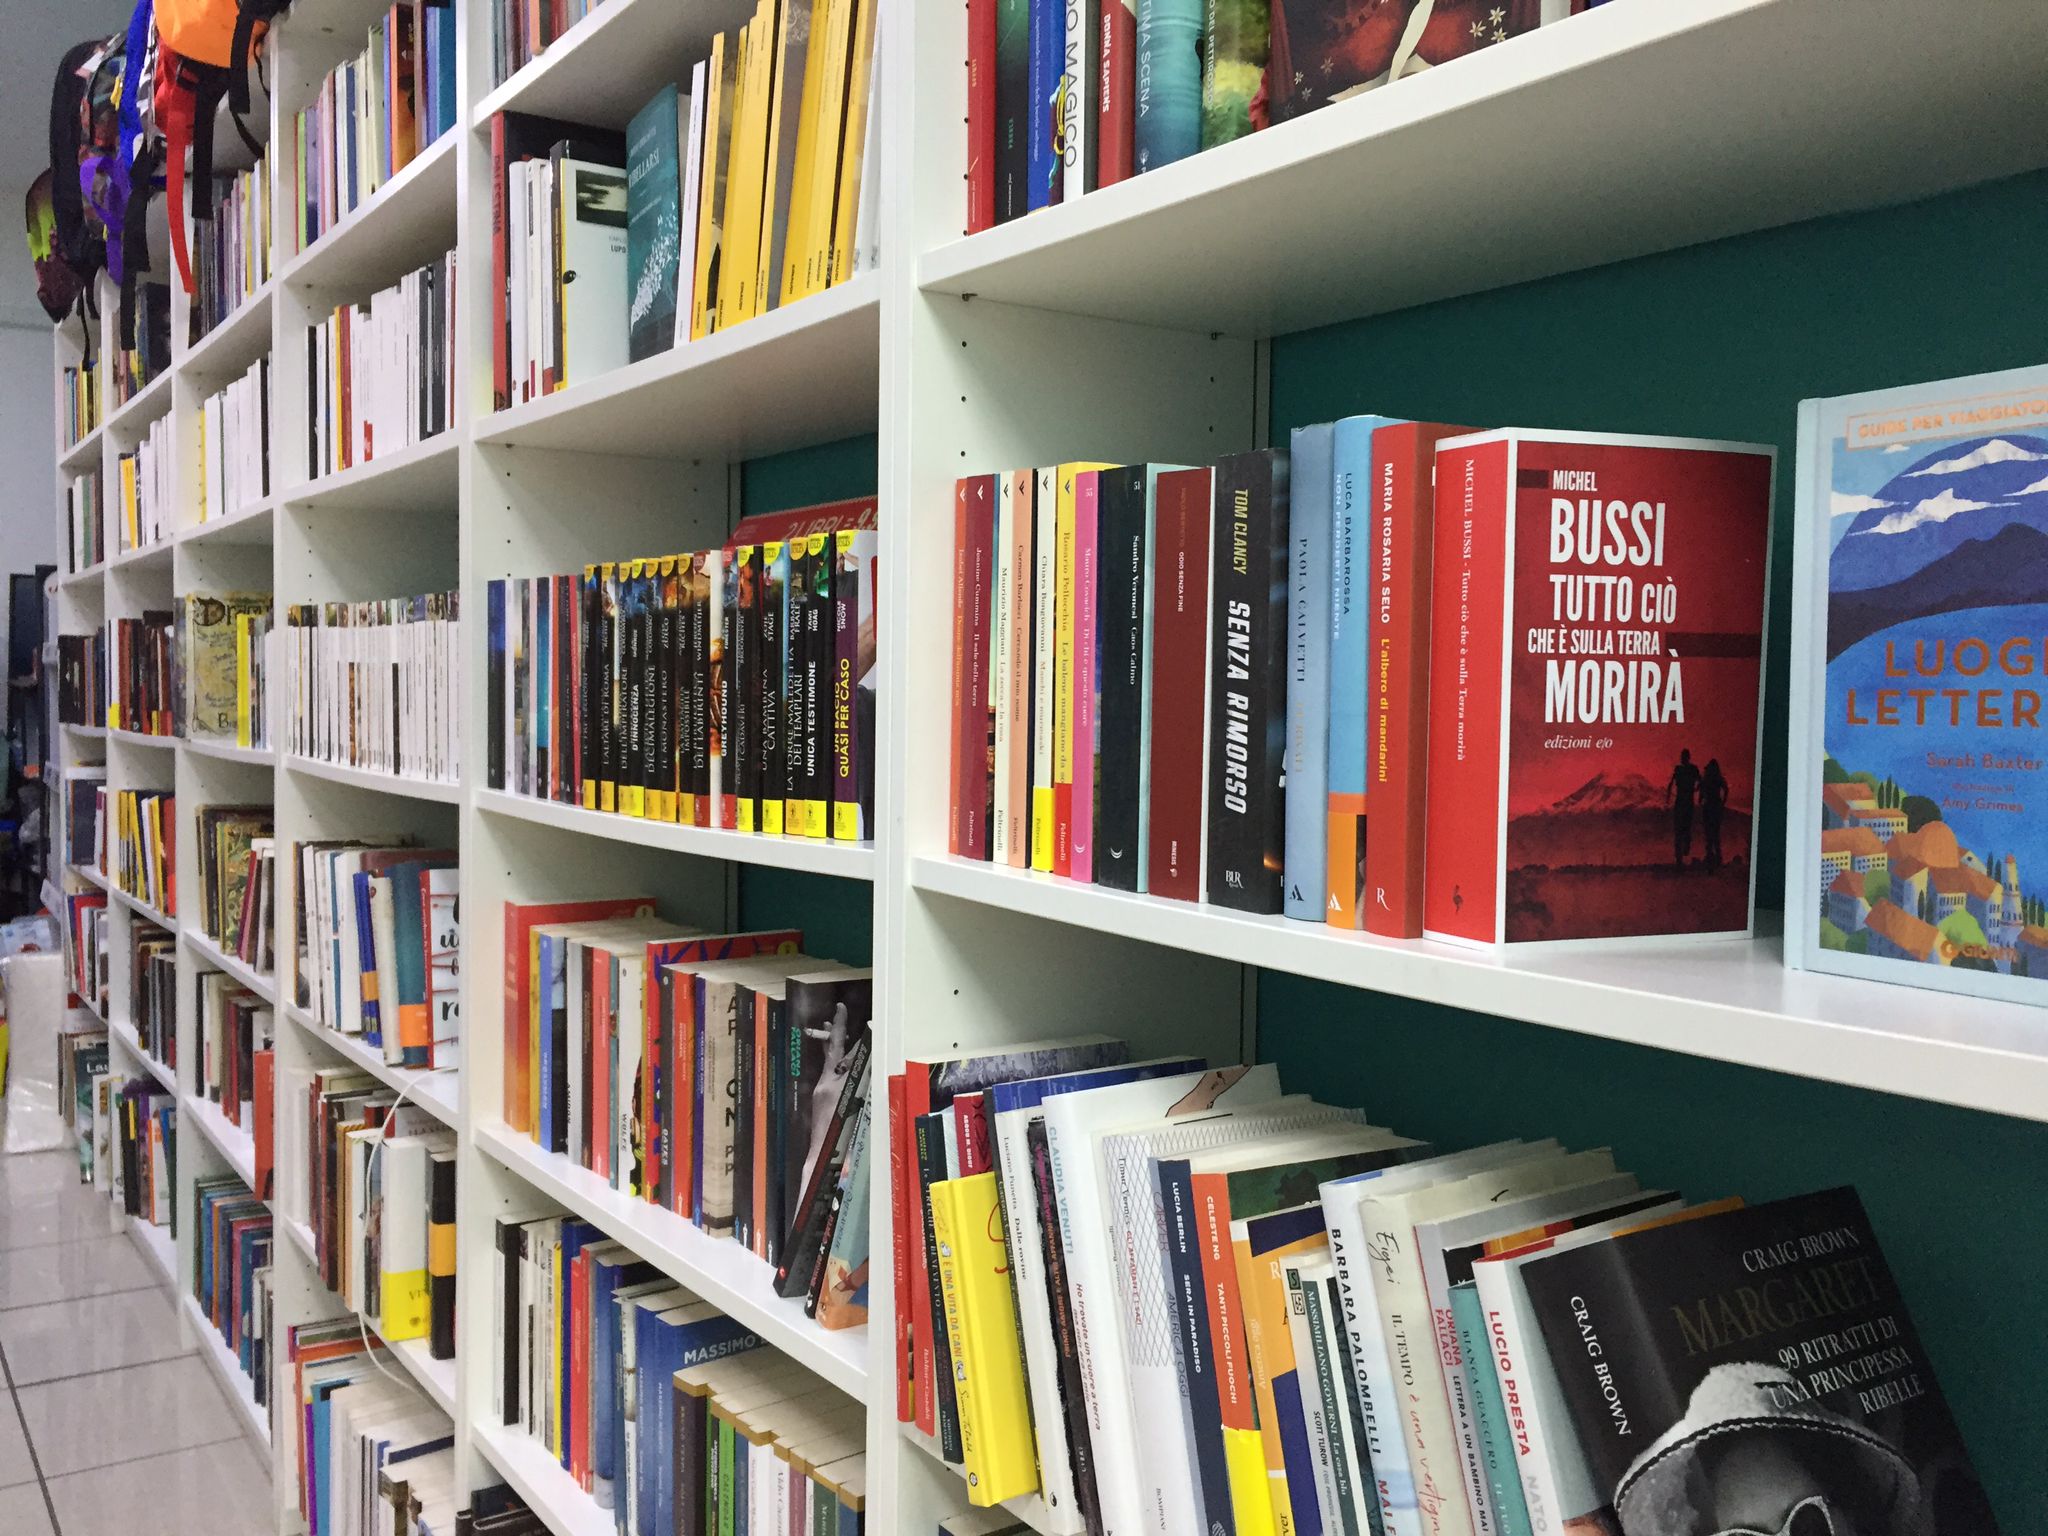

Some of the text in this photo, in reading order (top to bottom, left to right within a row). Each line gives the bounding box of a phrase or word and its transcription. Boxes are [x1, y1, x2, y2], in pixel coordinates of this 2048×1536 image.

[1065, 41, 1078, 168] MAGICO
[1102, 60, 1111, 113] SAPIENS
[1140, 50, 1151, 118] SCENA
[1858, 418, 1906, 440] GUIDE
[1912, 413, 1944, 431] PER
[1464, 459, 1474, 516] MICHEL
[1552, 469, 1598, 492] MICHEL
[1343, 473, 1353, 615] LUCA BARBAROSSA
[1462, 520, 1473, 559] BUSSI
[1549, 498, 1666, 567] BUSSI
[1296, 539, 1308, 683] PAOLA CALVETTI
[1460, 604, 1470, 622] ciò
[1461, 570, 1471, 601] Tutto
[1549, 575, 1677, 624] TUTTO CIÒ
[1379, 463, 1394, 783] MARIA ROSARIA SELO L'albero di mandarini
[1460, 625, 1470, 645] che
[1528, 626, 1661, 656] CHE È SULLA TERRA
[1224, 489, 1250, 814] TOM CLANCY SENZA RIMORSO
[1459, 658, 1469, 684] sulla
[1459, 688, 1468, 718] Terra
[1544, 648, 1685, 724] MORIRÀ
[793, 674, 802, 765] DEI TEMPLARI
[839, 658, 850, 777] QUASI PER CASO
[1457, 722, 1467, 760] morirà
[1544, 734, 1613, 751] edizioni e/o
[1927, 751, 2044, 771] Sarah Baxter
[1943, 797, 2024, 813] Amy Grimes
[1050, 1127, 1074, 1254] CLAUDIA VENUTI
[1118, 1157, 1127, 1187] Timur
[1207, 1196, 1219, 1242] CELESTE
[1741, 1225, 1860, 1274] CRAIG BROWN
[945, 1269, 962, 1358] UNA VITA DA CANI
[1153, 1192, 1191, 1398] CARVER AMERICA OGGI
[1177, 1217, 1186, 1253] BERLIN
[1183, 1273, 1192, 1302] SERA
[1189, 1317, 1201, 1373] PARADISO
[1216, 1282, 1225, 1314] TANTI
[1671, 1255, 1882, 1360] MARGARET
[684, 1335, 756, 1364] MASSIMO
[1078, 1301, 1090, 1338] trovato
[1087, 1356, 1096, 1388] cuore
[1221, 1316, 1232, 1359] PICCOLI
[1307, 1290, 1329, 1376] MASSIMILIANO
[1324, 1377, 1337, 1435] GOVERNI
[1434, 1308, 1453, 1367] FALLACI
[1445, 1309, 1462, 1366] ORIANA
[1570, 1295, 1632, 1436] CRAIG BROWN
[1778, 1315, 1900, 1371] 99 RITRATTI DI
[1225, 1360, 1237, 1404] FUOCHI
[1331, 1228, 1393, 1518] BARBARA PALOMBELLI MAI
[1392, 1314, 1426, 1449] IL TEMPO una
[1452, 1375, 1466, 1419] LETTERA
[1768, 1345, 1913, 1411] UNA PRINCIPESSA
[1860, 1375, 1925, 1416] RIBELLE
[1313, 1411, 1329, 1467] SCOTT TUROW
[1462, 1331, 1511, 1535] BIANCA GUACCERO TUO
[1464, 1433, 1473, 1450] UN
[1488, 1310, 1549, 1534] LUCIO PRESTA NATO
[1467, 1453, 1484, 1508] BAMBINO
[1479, 1509, 1489, 1533] MAI
